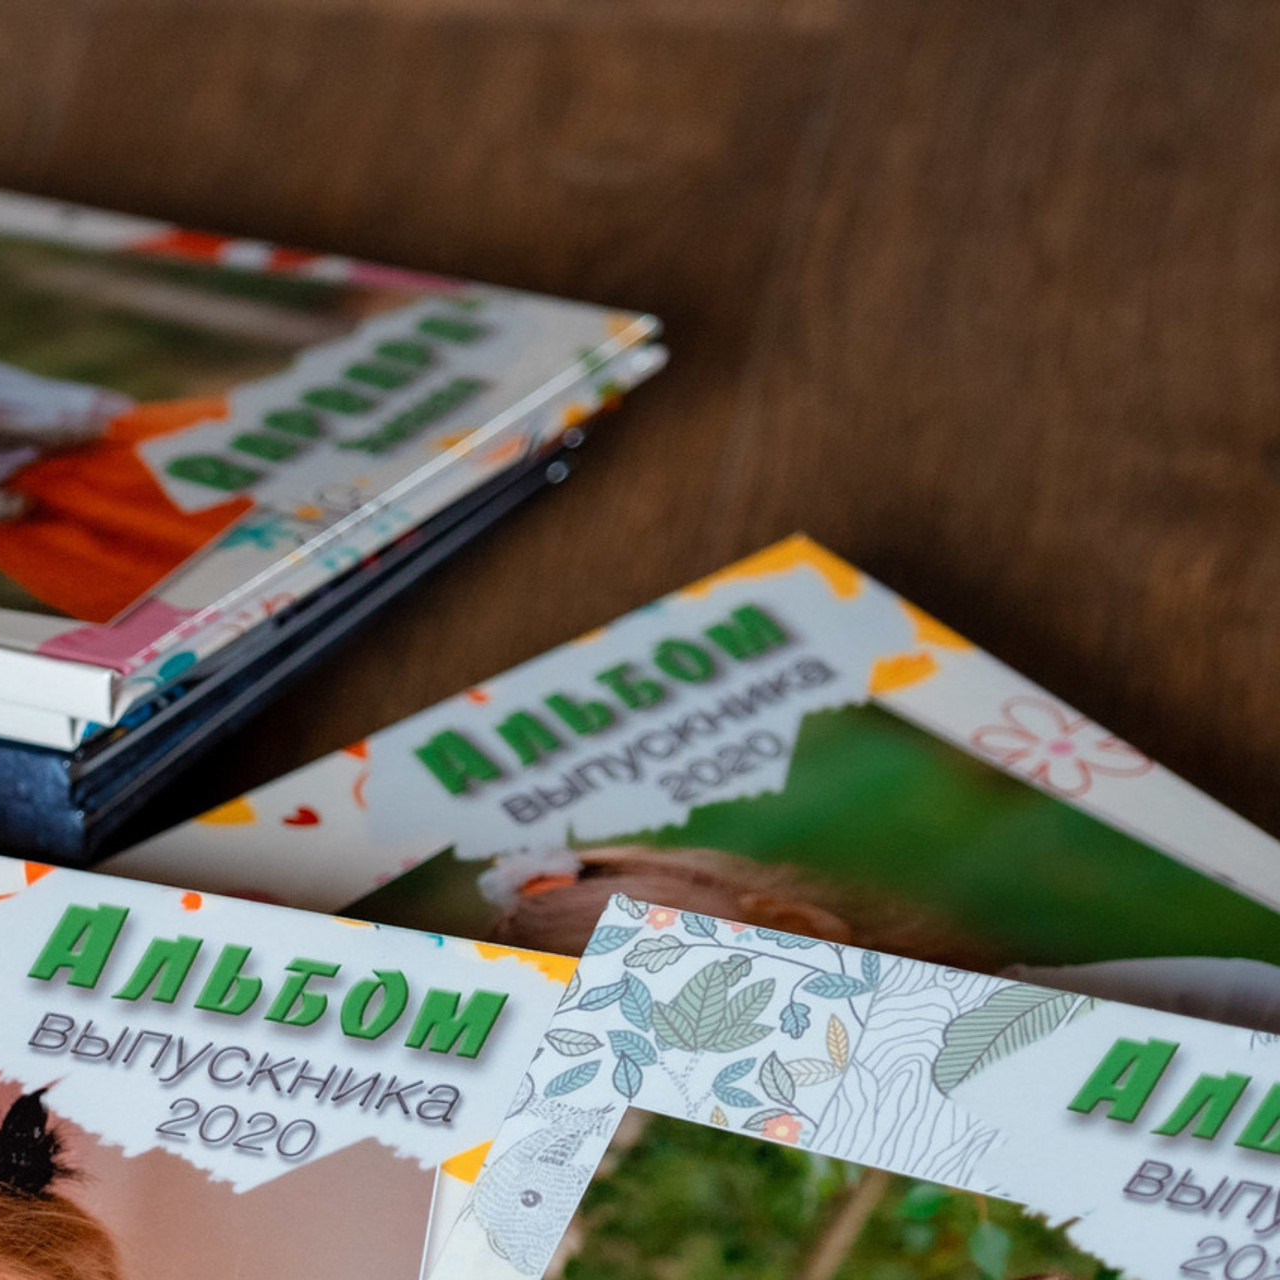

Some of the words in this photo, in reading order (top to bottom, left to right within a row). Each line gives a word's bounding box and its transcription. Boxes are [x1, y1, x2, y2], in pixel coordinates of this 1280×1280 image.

[501, 655, 836, 824] выпускника
[658, 730, 783, 800] 2020
[28, 1012, 462, 1123] выпускника
[156, 1098, 317, 1157] 2020
